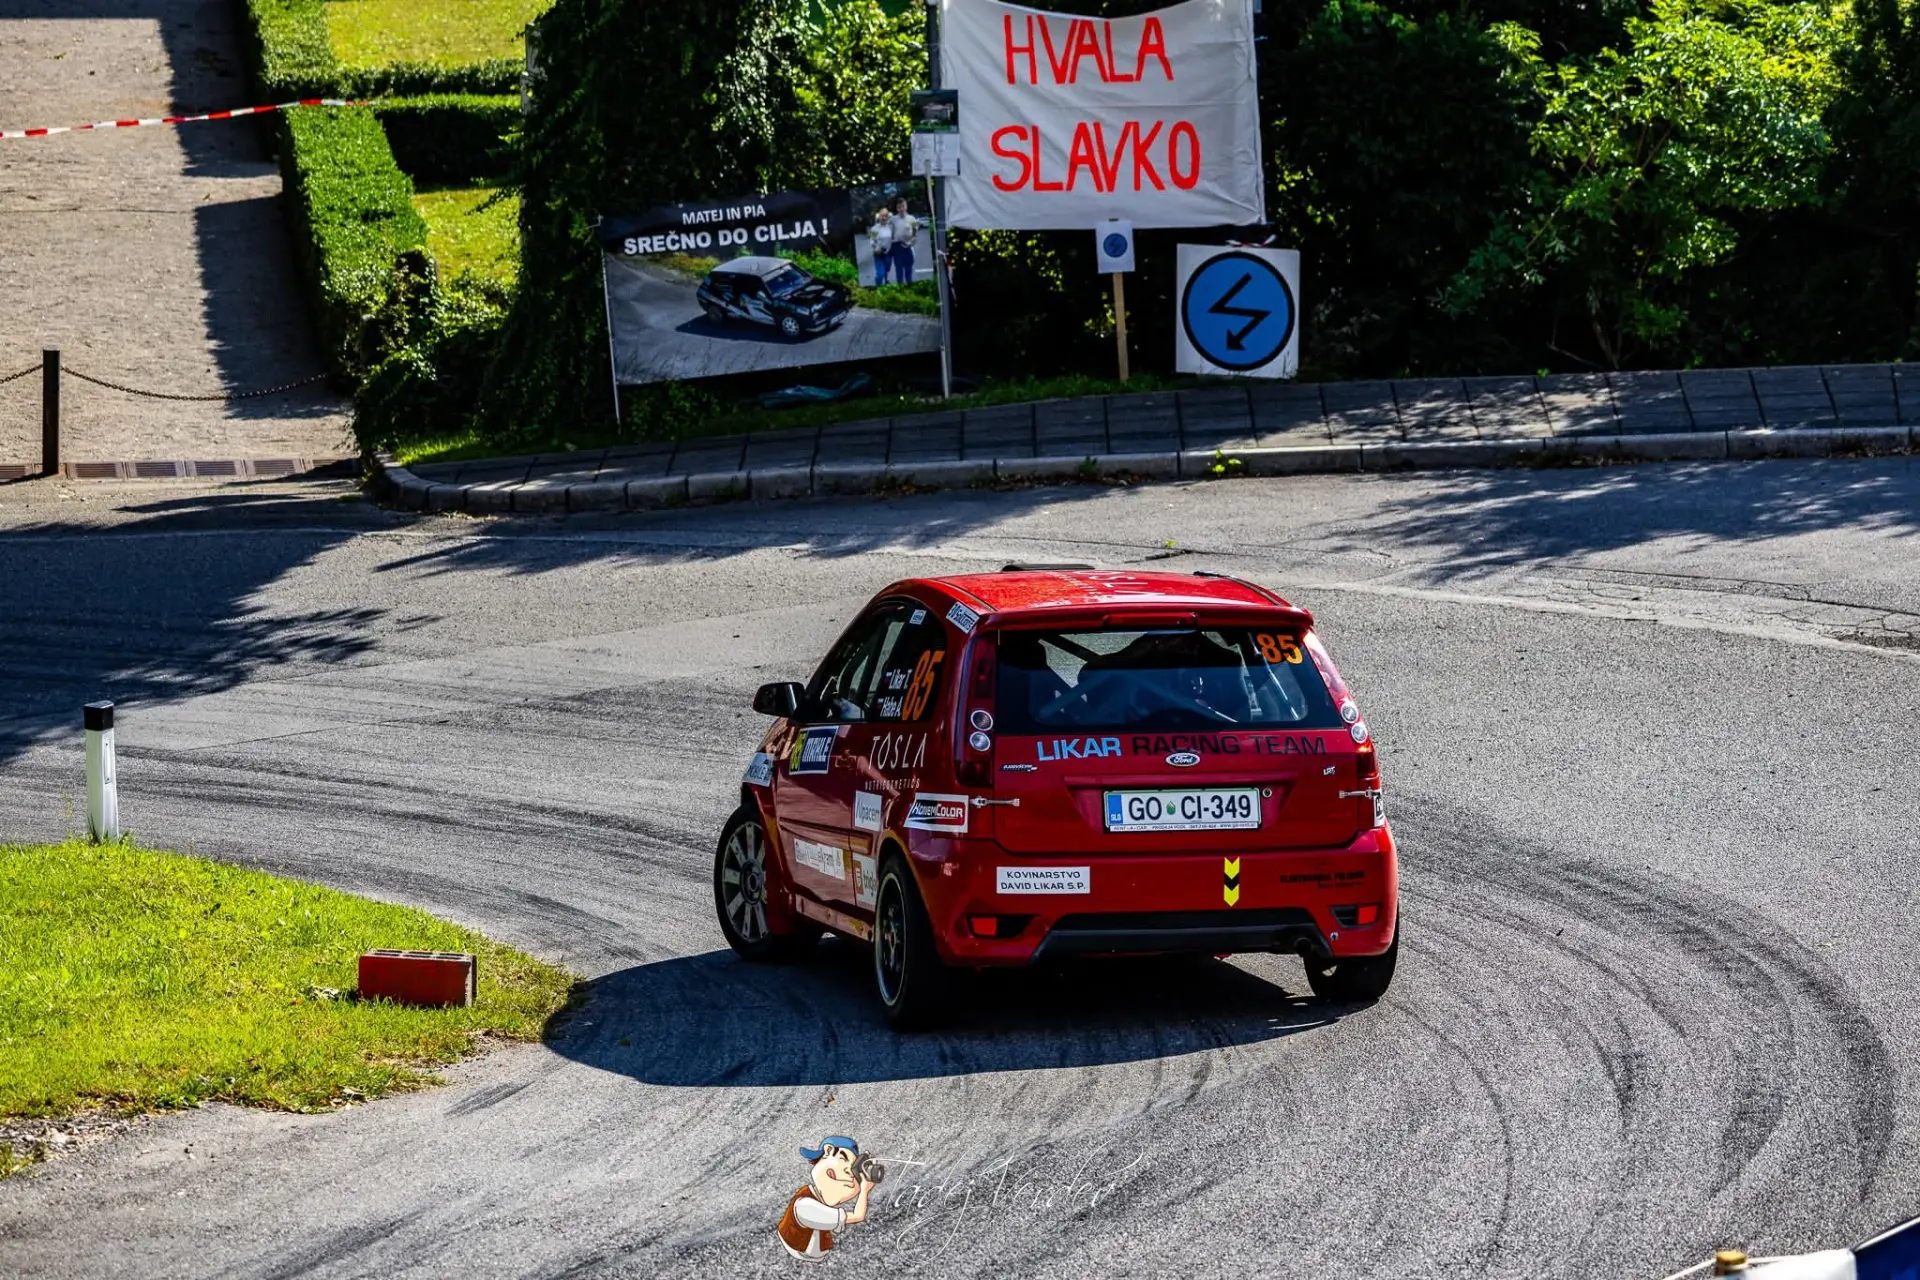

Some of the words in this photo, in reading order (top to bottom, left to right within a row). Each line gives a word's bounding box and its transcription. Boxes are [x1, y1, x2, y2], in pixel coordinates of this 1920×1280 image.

[1003, 14, 1175, 85] HVALA
[991, 120, 1201, 193] SLAVKO
[682, 209, 724, 225] MATEJ
[726, 207, 742, 221] IN
[743, 204, 767, 219] PIA
[624, 230, 712, 255] SREČNO
[718, 228, 749, 247] DO
[754, 220, 817, 243] CILJA
[1256, 633, 1303, 664] 85
[902, 650, 945, 720] 85
[868, 731, 927, 770] TOSLA
[1037, 737, 1122, 762] LIKAR
[1131, 735, 1241, 757] RACING
[1247, 734, 1327, 756] TEAM
[1128, 797, 1163, 821] GO
[1181, 794, 1251, 820] CI-349
[1001, 882, 1032, 890] DAVID
[1034, 882, 1065, 890] LIKAR
[1006, 871, 1081, 879] KOVINARSTVO
